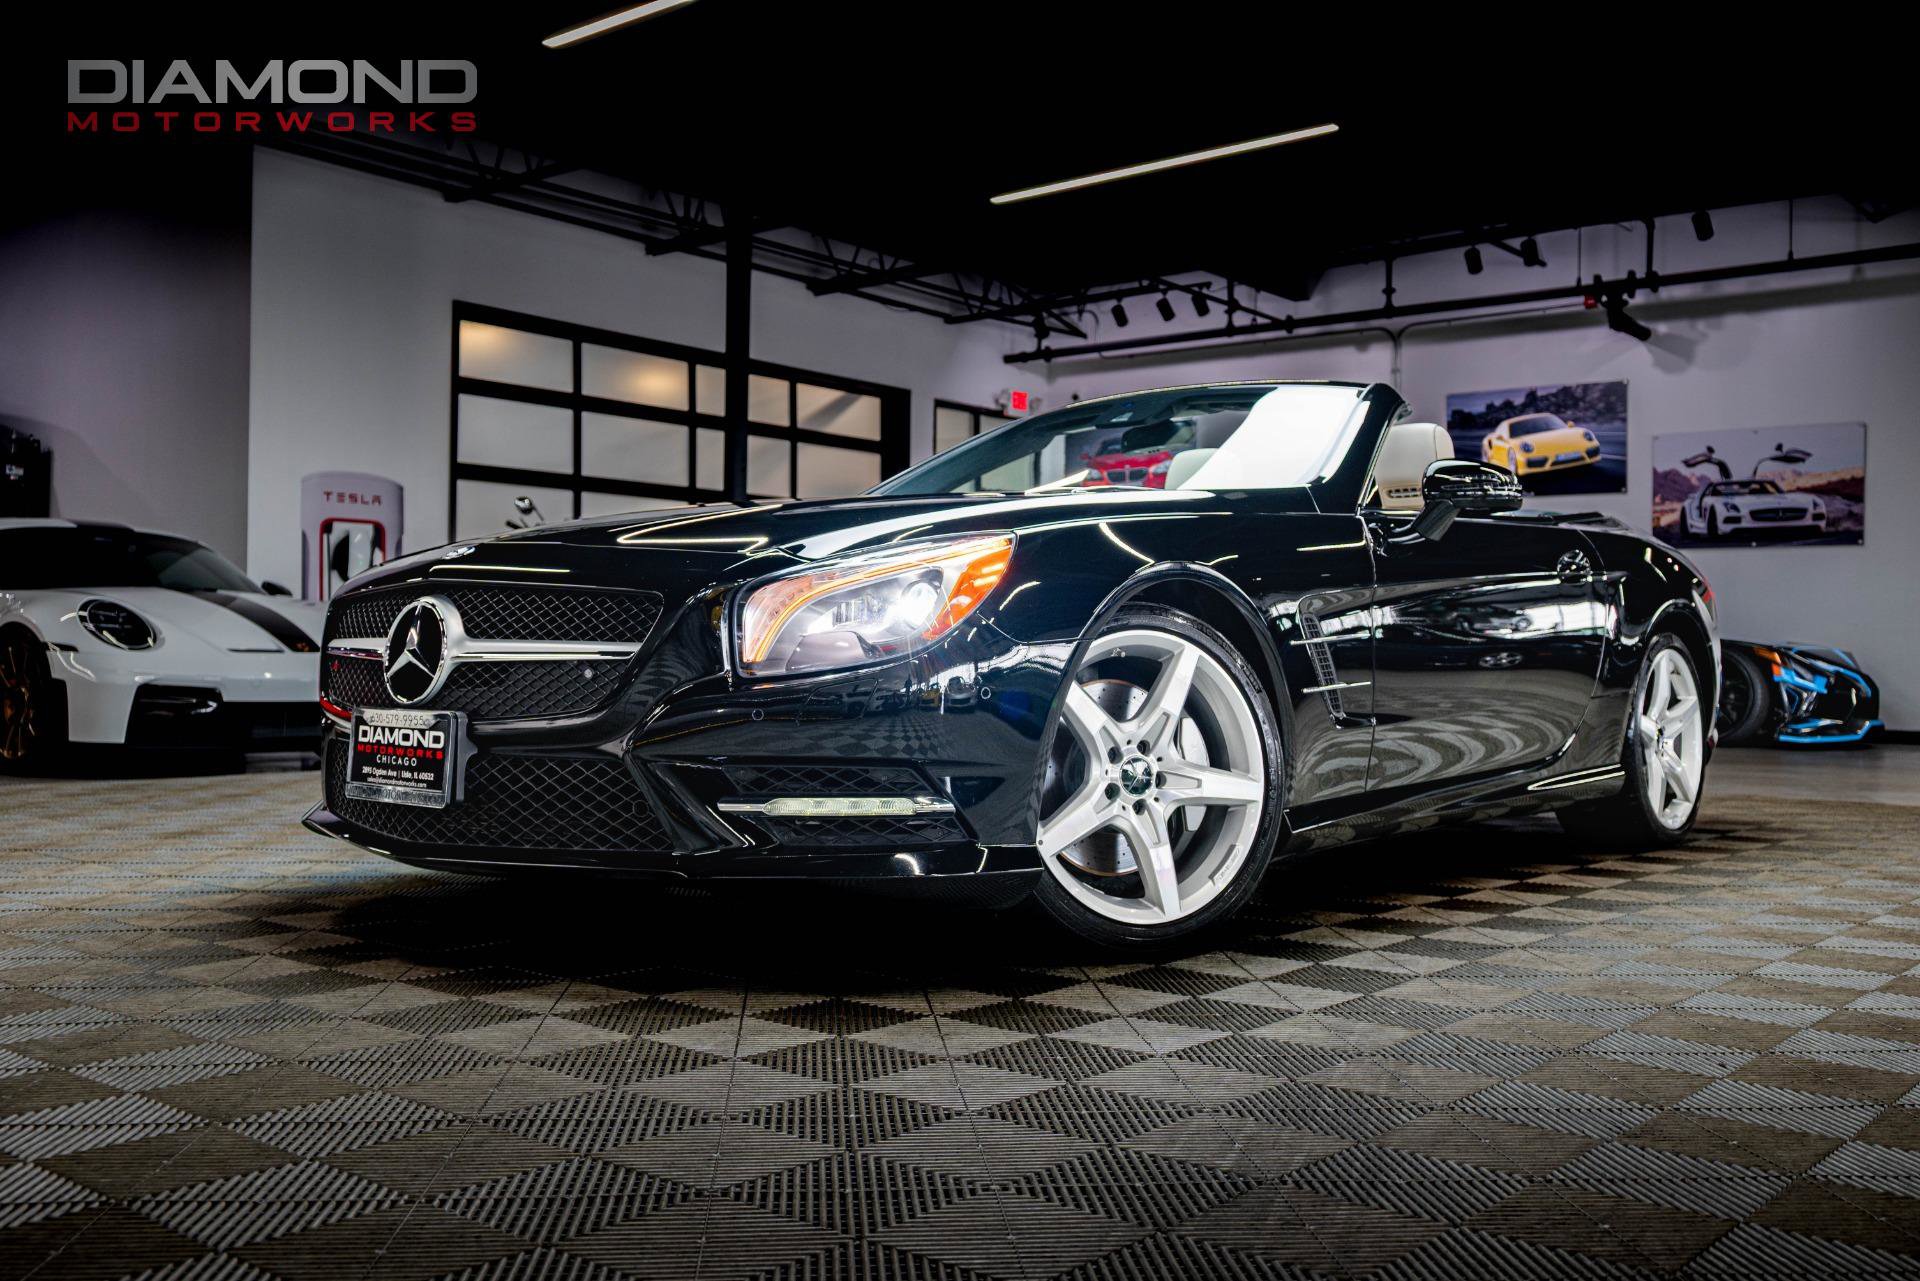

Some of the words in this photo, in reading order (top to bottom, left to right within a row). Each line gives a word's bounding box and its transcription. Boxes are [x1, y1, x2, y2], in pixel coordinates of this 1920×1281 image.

[323, 491, 382, 506] TESLA
[358, 725, 445, 749] DIAMOND
[357, 743, 443, 760] MOTORWORKS
[376, 754, 417, 767] CHICAGO
[373, 767, 387, 776] Ogden
[387, 769, 397, 778] Ave
